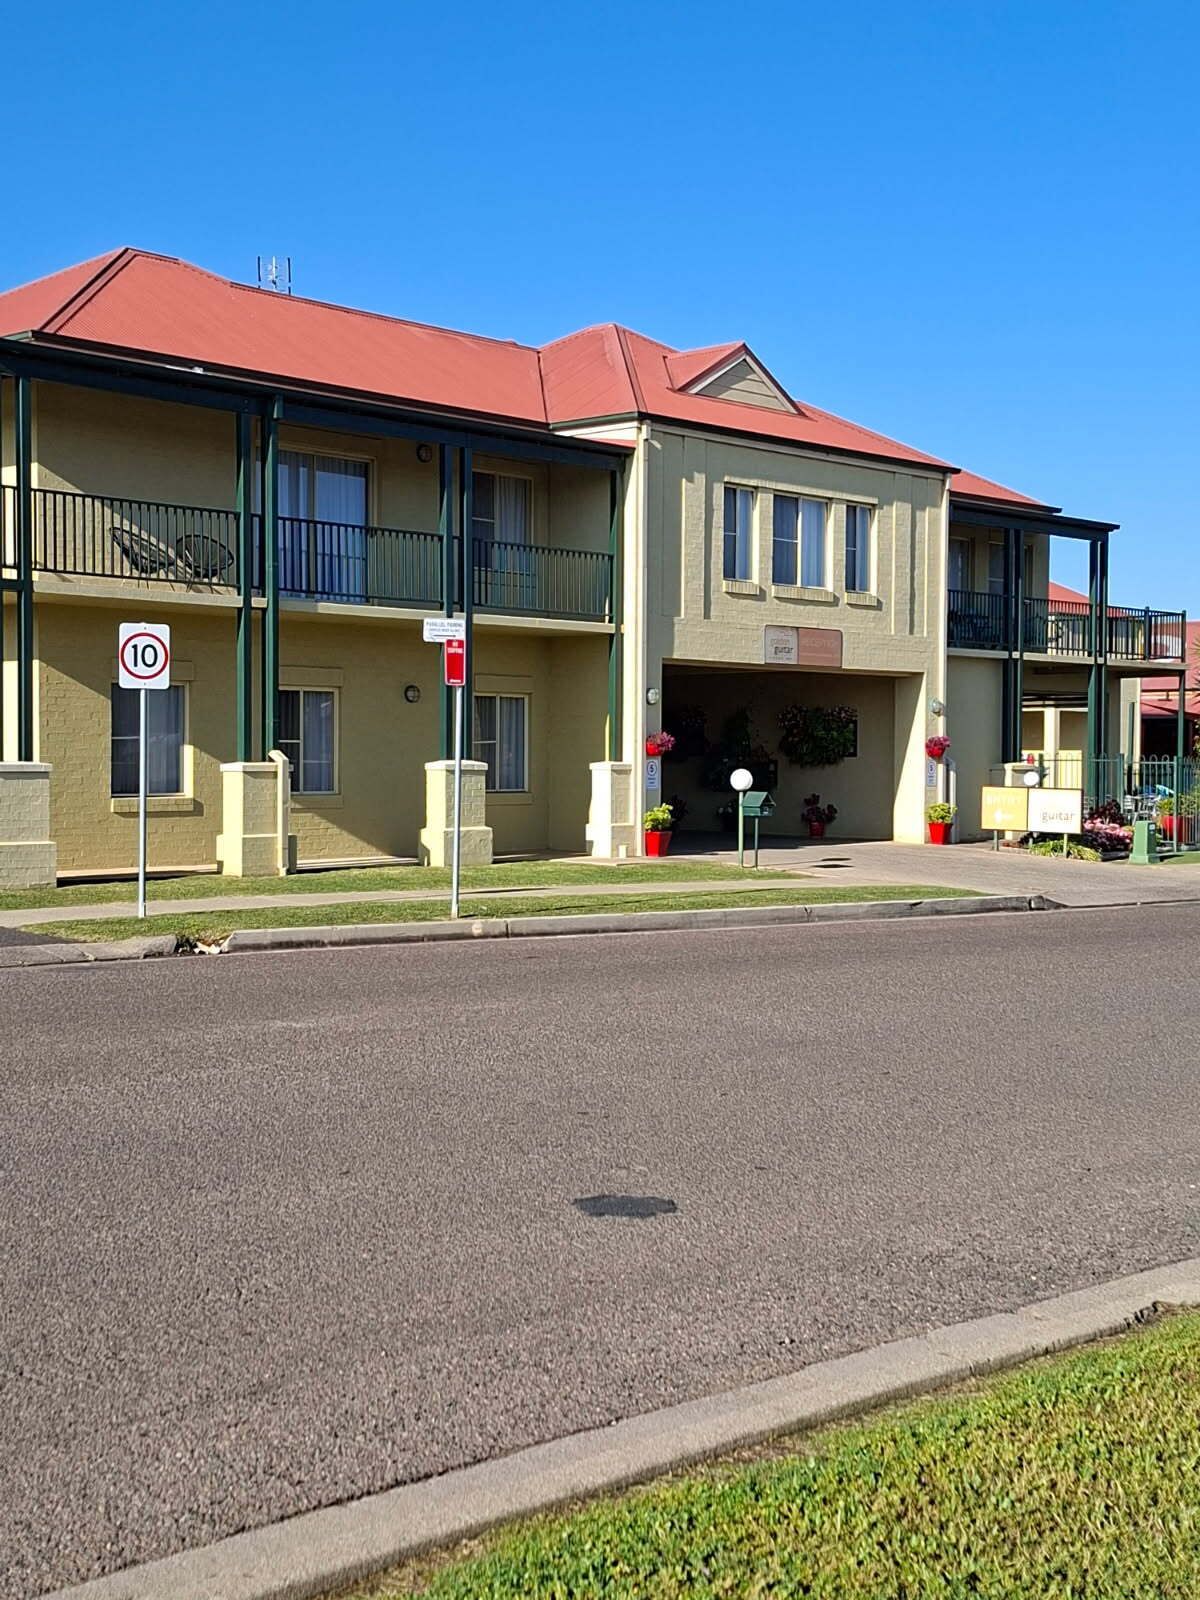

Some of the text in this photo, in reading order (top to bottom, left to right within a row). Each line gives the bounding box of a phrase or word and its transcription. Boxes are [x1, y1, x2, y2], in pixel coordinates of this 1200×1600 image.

[131, 643, 159, 668] 10
[774, 646, 794, 656] guitar
[1041, 811, 1075, 824] guitar
